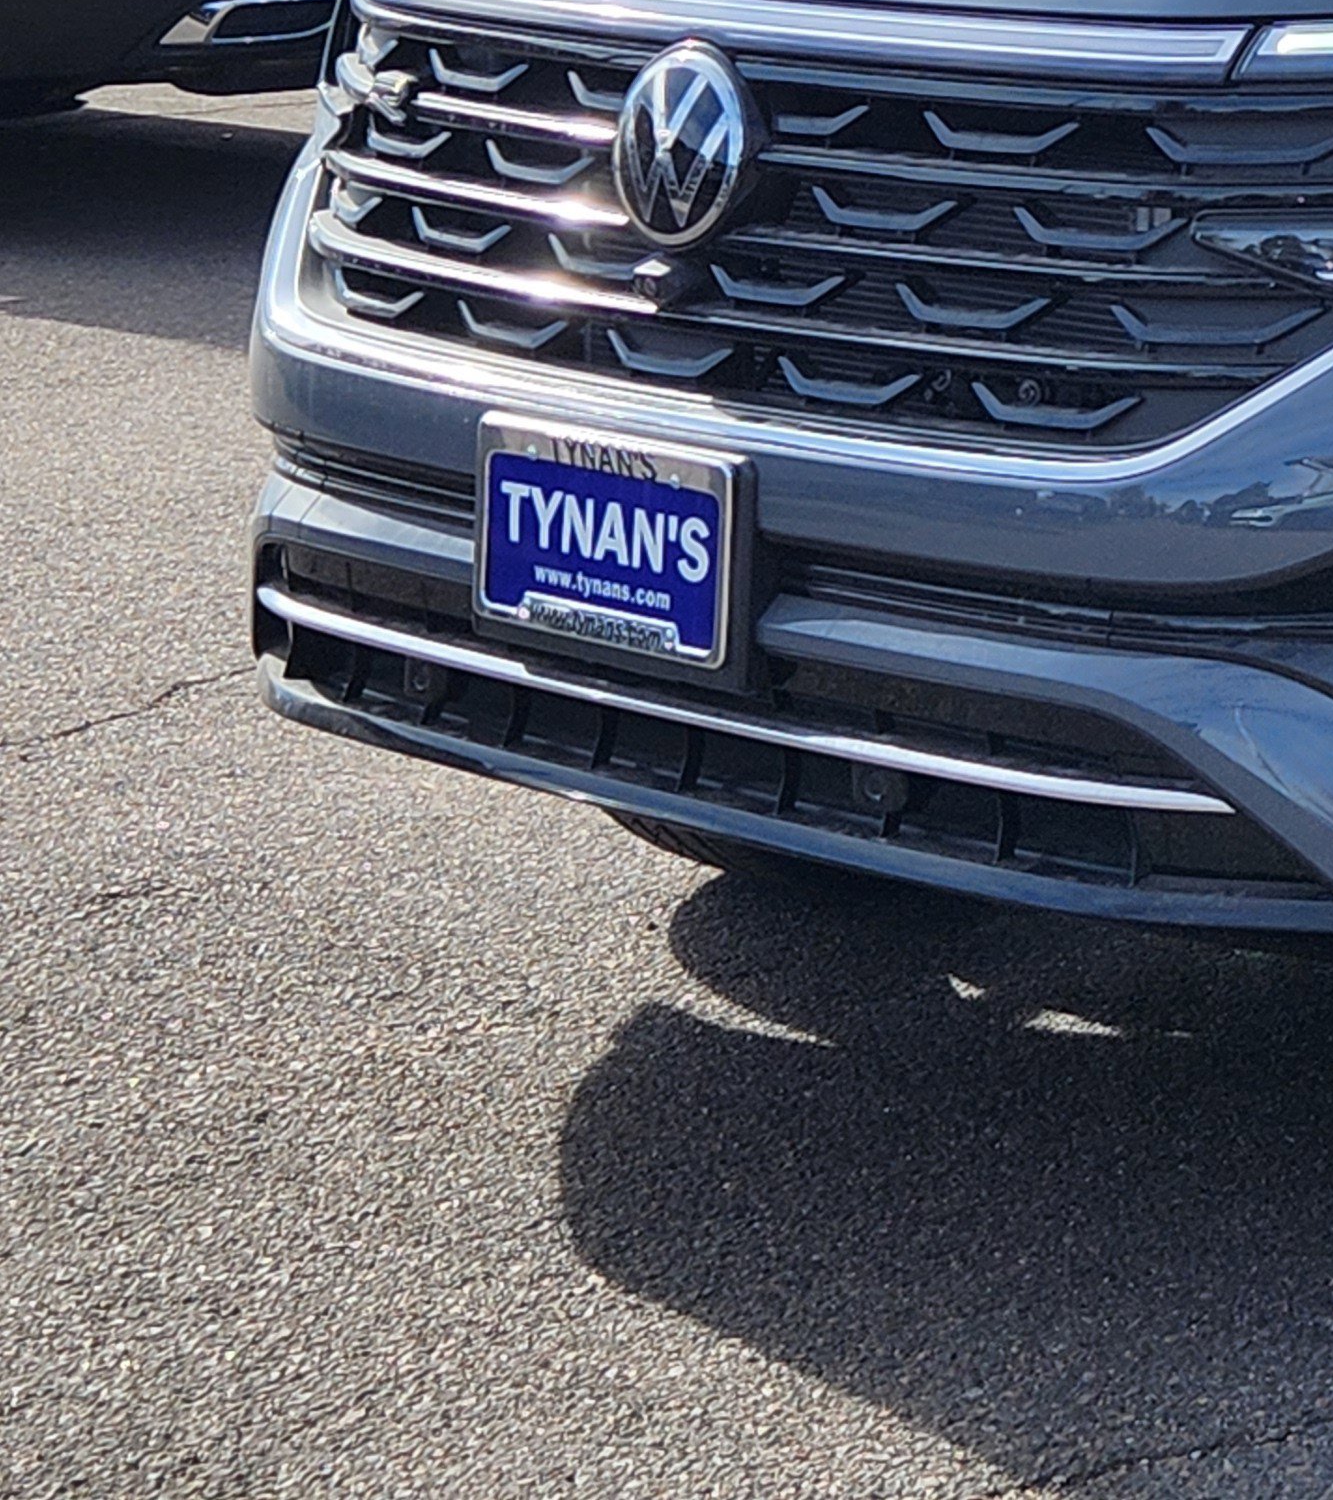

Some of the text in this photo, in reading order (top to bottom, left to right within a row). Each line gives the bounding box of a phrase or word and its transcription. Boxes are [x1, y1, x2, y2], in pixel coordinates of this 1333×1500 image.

[551, 436, 658, 481] TYNAN'S
[500, 480, 711, 583] TYNAN'S
[533, 564, 671, 611] www.tynans.com
